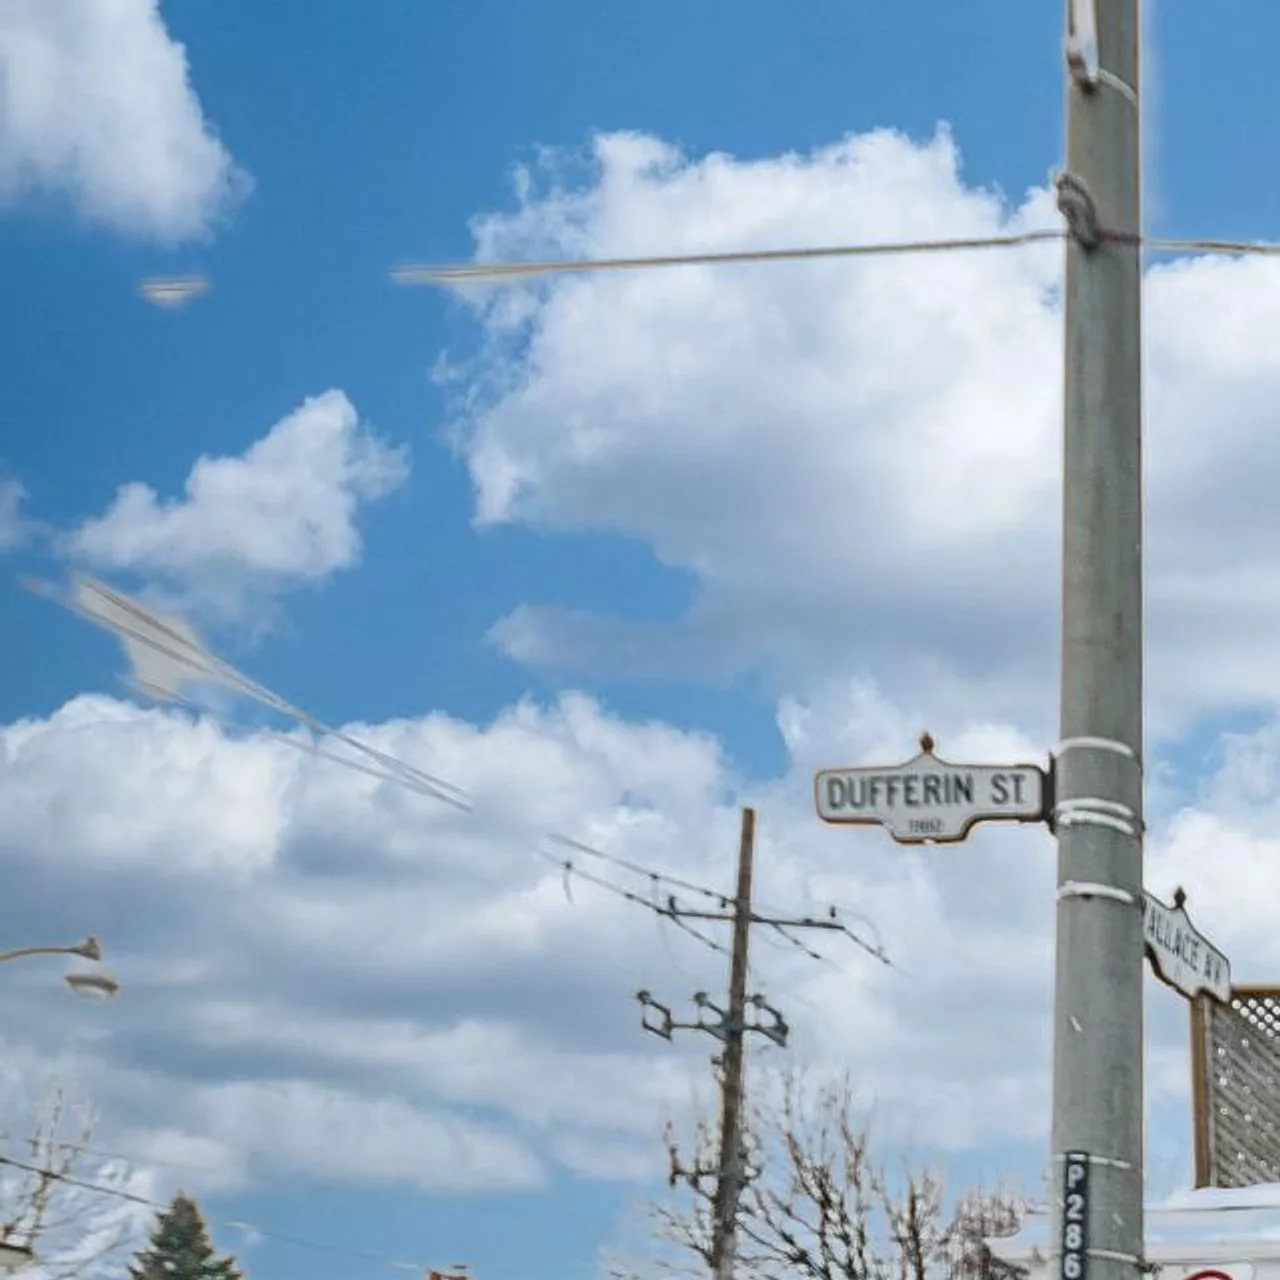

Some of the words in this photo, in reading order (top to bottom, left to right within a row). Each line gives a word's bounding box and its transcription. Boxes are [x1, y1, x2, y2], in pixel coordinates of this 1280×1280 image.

[827, 773, 974, 810] DUFFERIN
[990, 773, 1026, 805] ST
[1147, 905, 1198, 972] ALLACE
[1063, 1164, 1084, 1280] P286
